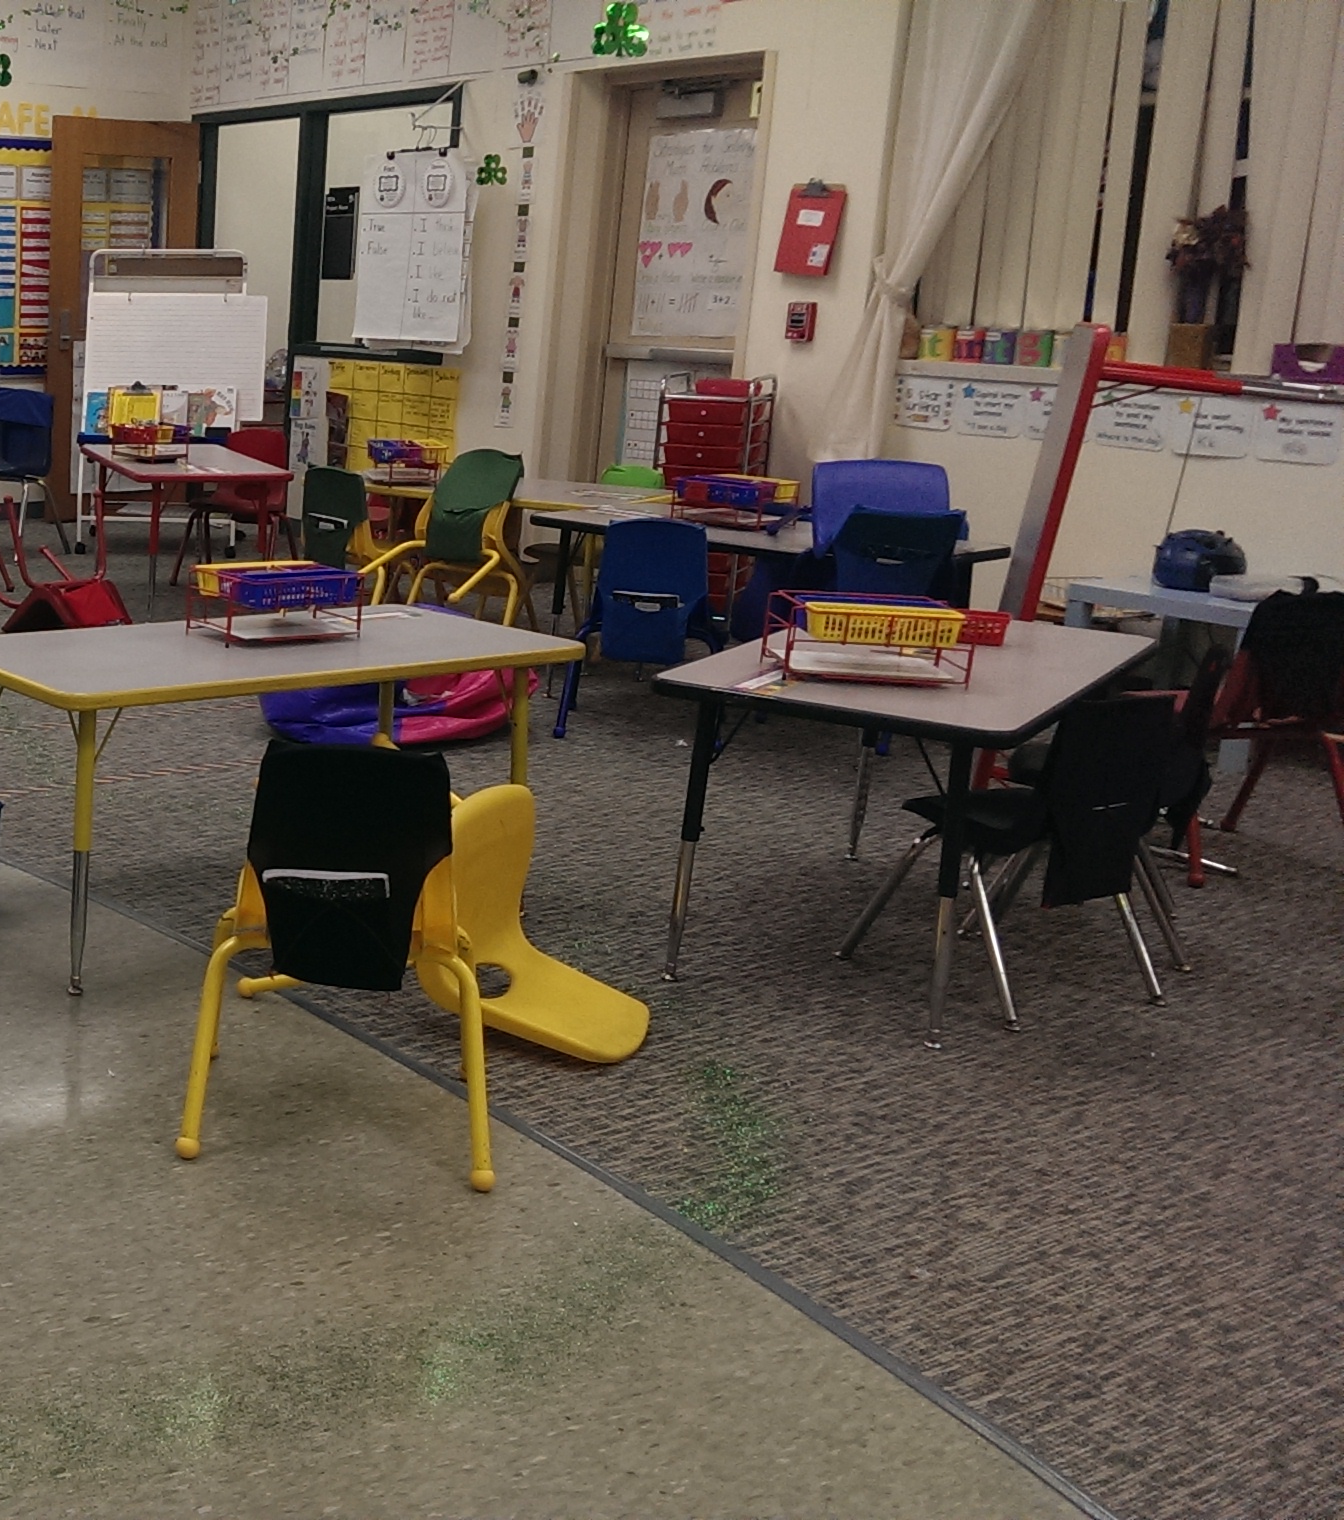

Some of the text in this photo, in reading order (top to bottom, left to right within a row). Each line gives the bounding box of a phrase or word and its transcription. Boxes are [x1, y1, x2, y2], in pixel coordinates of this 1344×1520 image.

[36, 19, 62, 34] Later
[118, 12, 146, 36] Finally
[35, 38, 58, 50] Next
[150, 33, 168, 48] end
[368, 218, 385, 232] True
[420, 218, 427, 232] I
[367, 241, 387, 255] False
[417, 241, 424, 255] I
[416, 265, 422, 279] I
[412, 288, 457, 303] I do not
